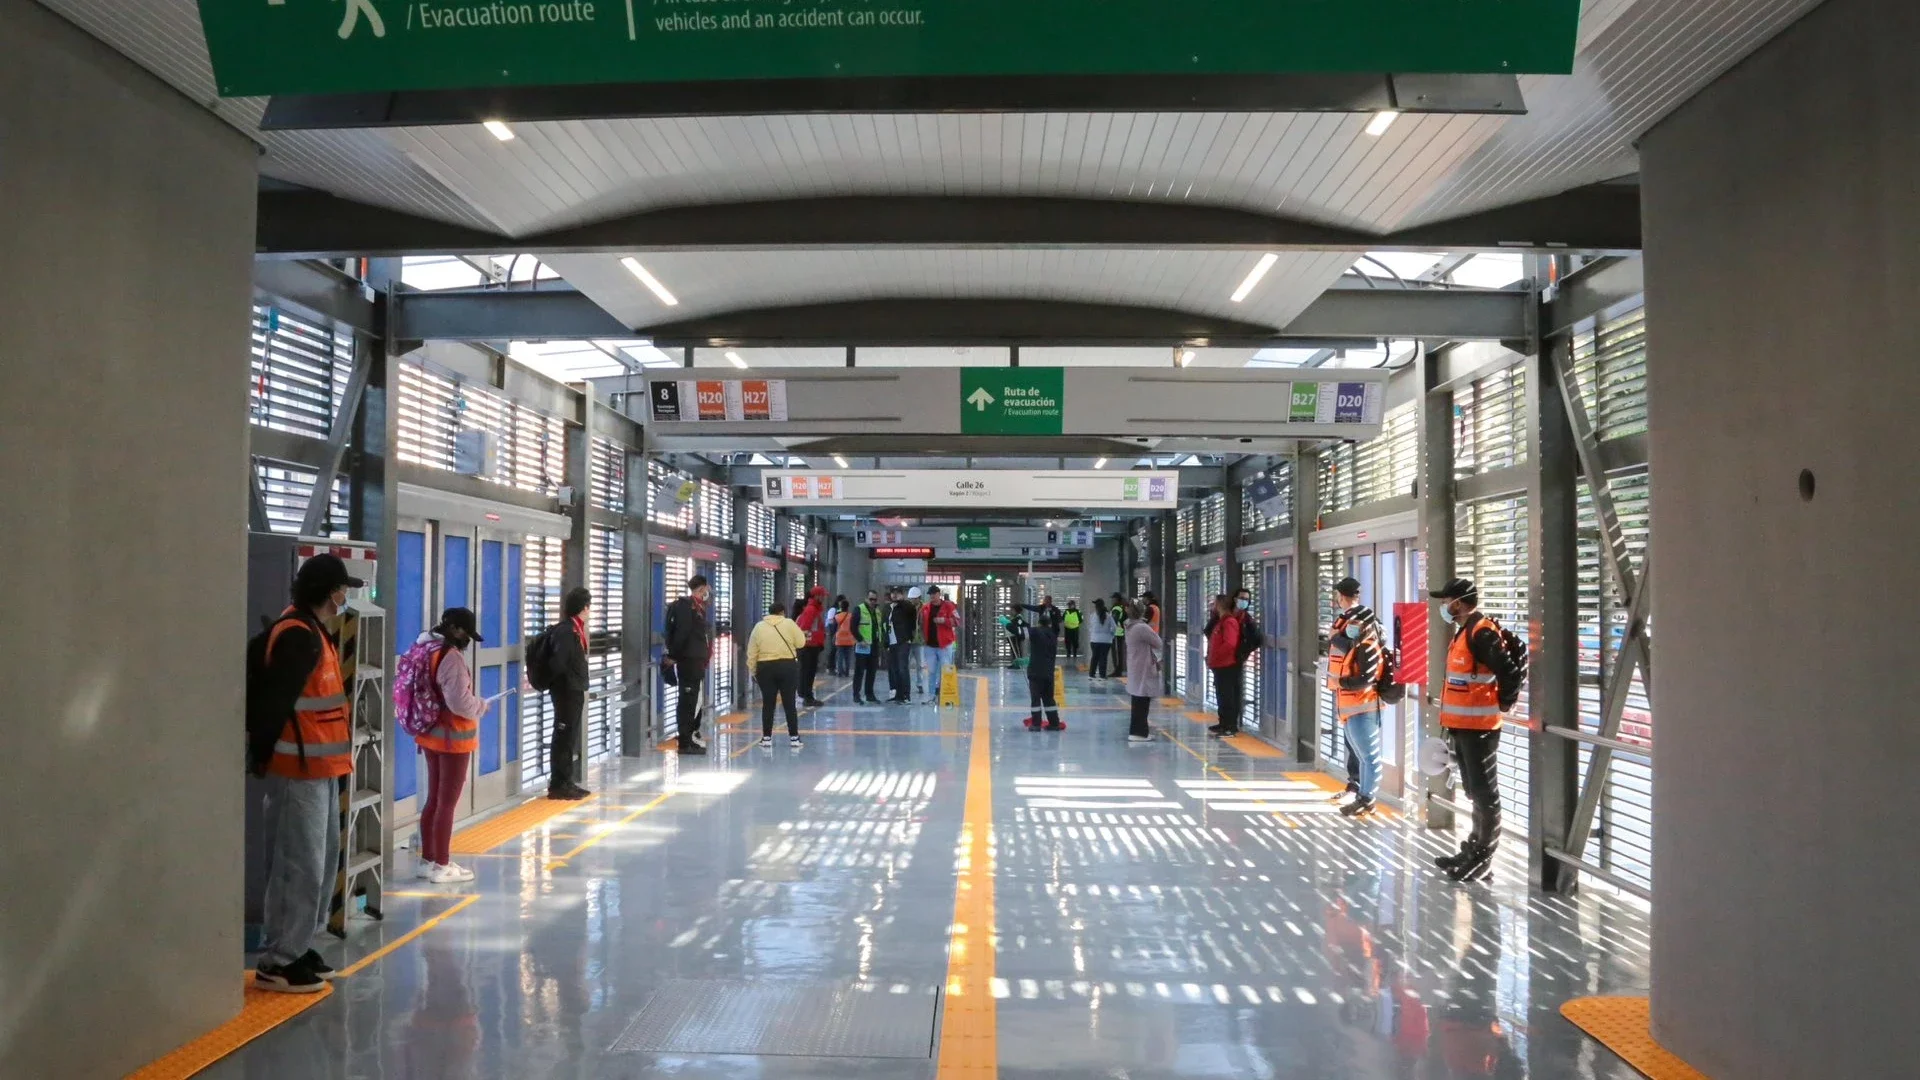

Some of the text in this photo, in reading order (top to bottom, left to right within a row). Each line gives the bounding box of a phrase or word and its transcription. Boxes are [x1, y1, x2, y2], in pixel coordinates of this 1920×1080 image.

[419, 1, 533, 29] Evacuation
[539, 0, 595, 21] route
[655, 8, 925, 32] vehicles and an accident can occur.
[660, 388, 670, 400] 8
[1004, 386, 1040, 396] Ruta de
[698, 391, 723, 404] H20
[743, 391, 767, 404] H27
[1004, 396, 1055, 407] evacuación
[1292, 393, 1316, 406] B27
[1338, 395, 1362, 407] D20
[1008, 408, 1041, 416] Evacuation
[1042, 408, 1059, 416] route
[793, 482, 807, 490] H20
[819, 482, 832, 490] H27
[956, 481, 985, 489] Calle 26
[1150, 485, 1165, 493] D20
